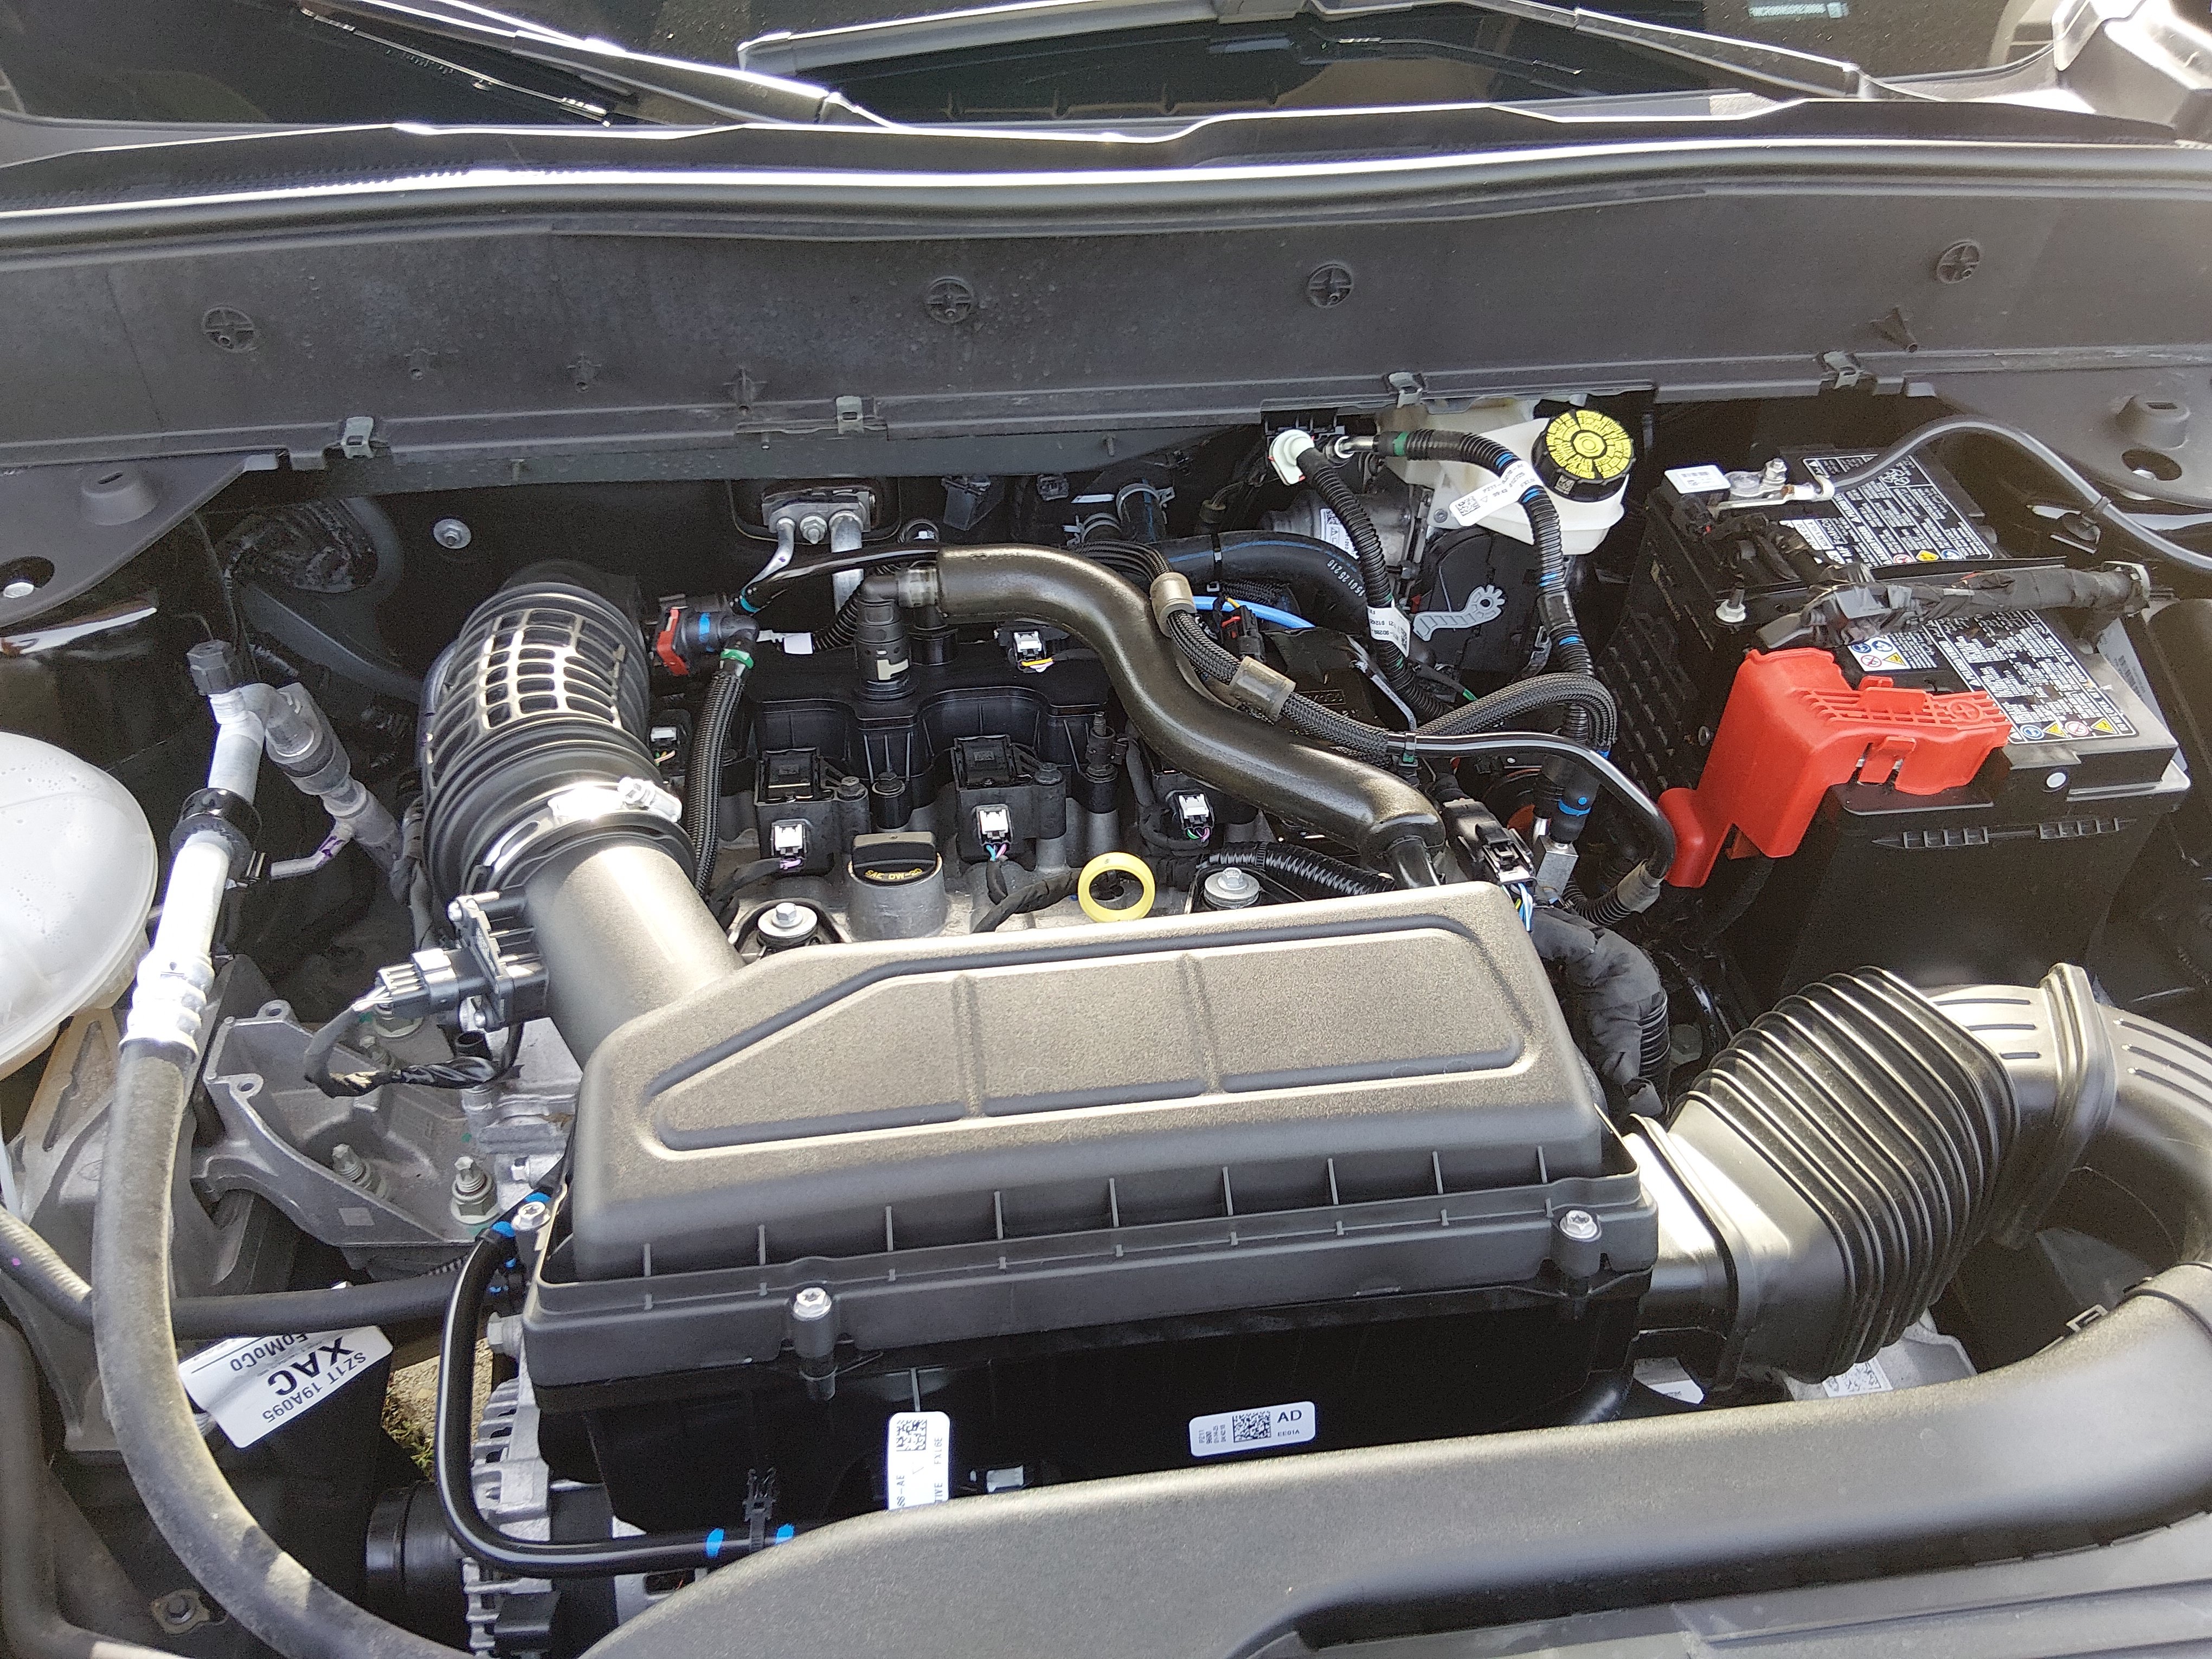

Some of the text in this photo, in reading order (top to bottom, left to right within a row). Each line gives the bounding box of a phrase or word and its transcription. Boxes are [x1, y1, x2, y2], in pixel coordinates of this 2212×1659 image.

[1817, 518, 1845, 544] FoMoCo
[864, 869, 885, 879] SAE
[267, 1336, 355, 1396] XAC
[262, 1381, 323, 1424] 19A095
[1277, 1409, 1302, 1423] AD
